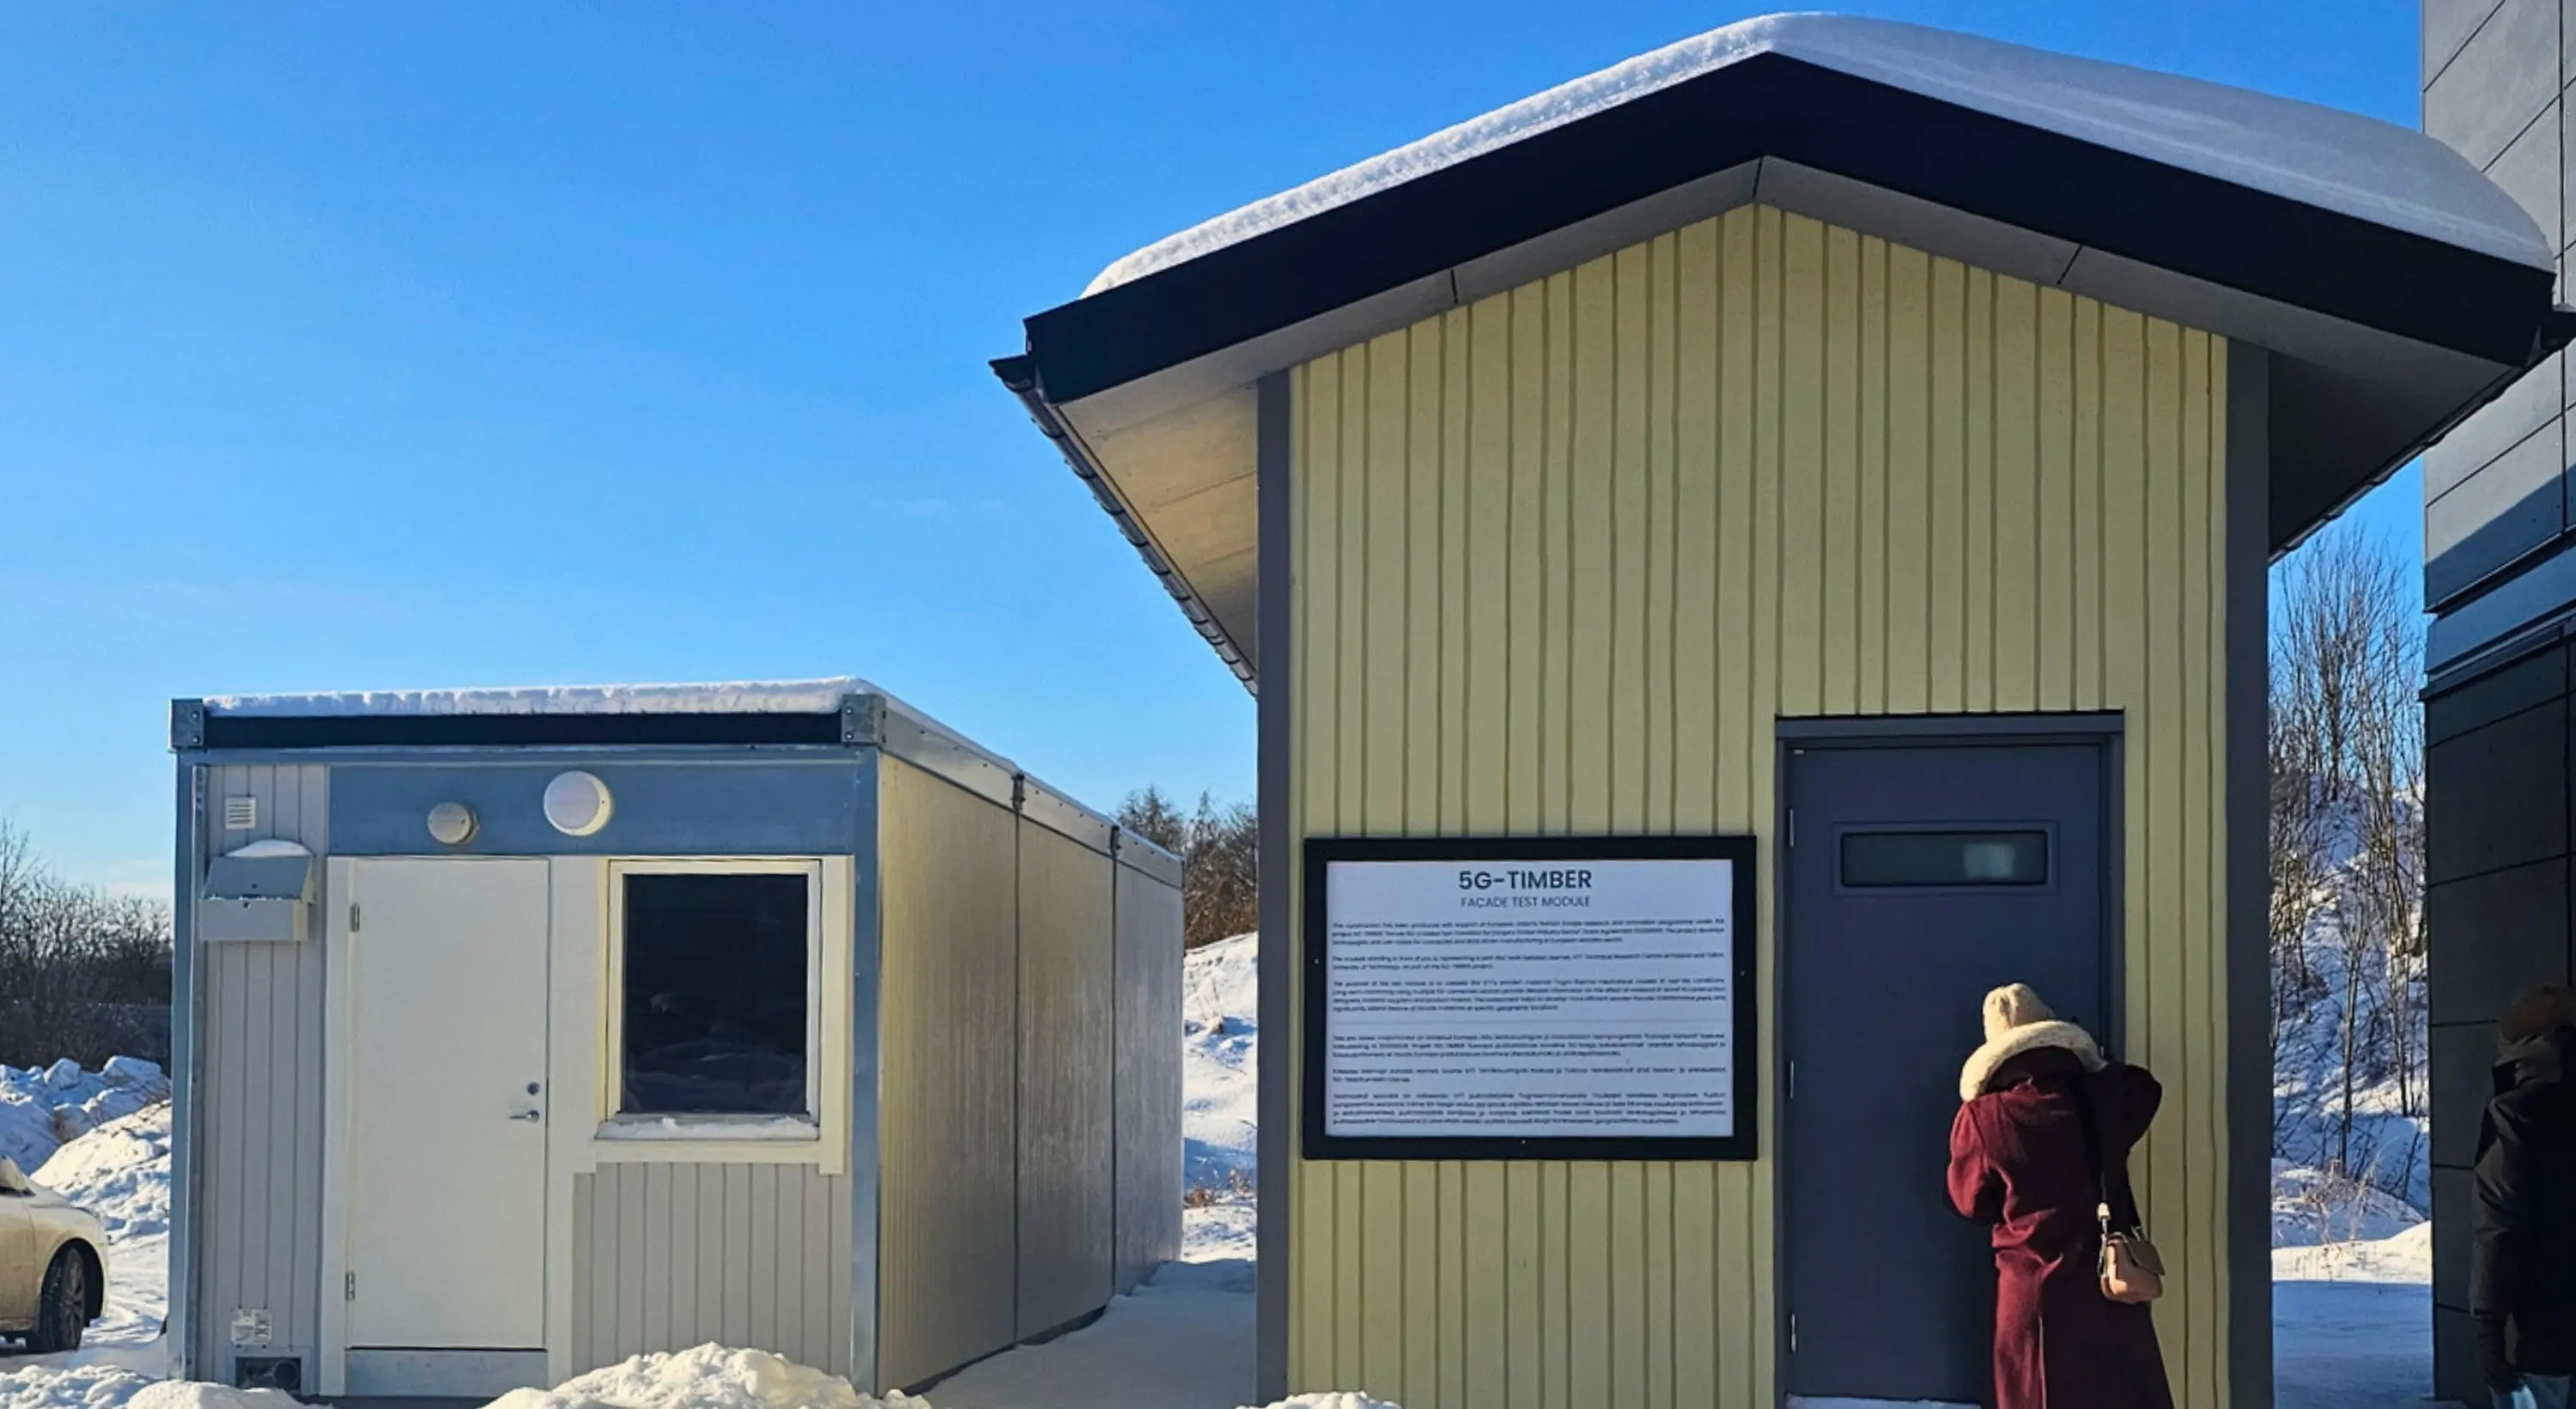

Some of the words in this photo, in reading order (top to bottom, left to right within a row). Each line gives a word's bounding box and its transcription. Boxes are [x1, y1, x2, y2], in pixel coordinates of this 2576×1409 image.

[1459, 870, 1592, 890] 5G-TIMBER
[1512, 896, 1538, 908] TEST
[1541, 896, 1590, 908] MODULE
